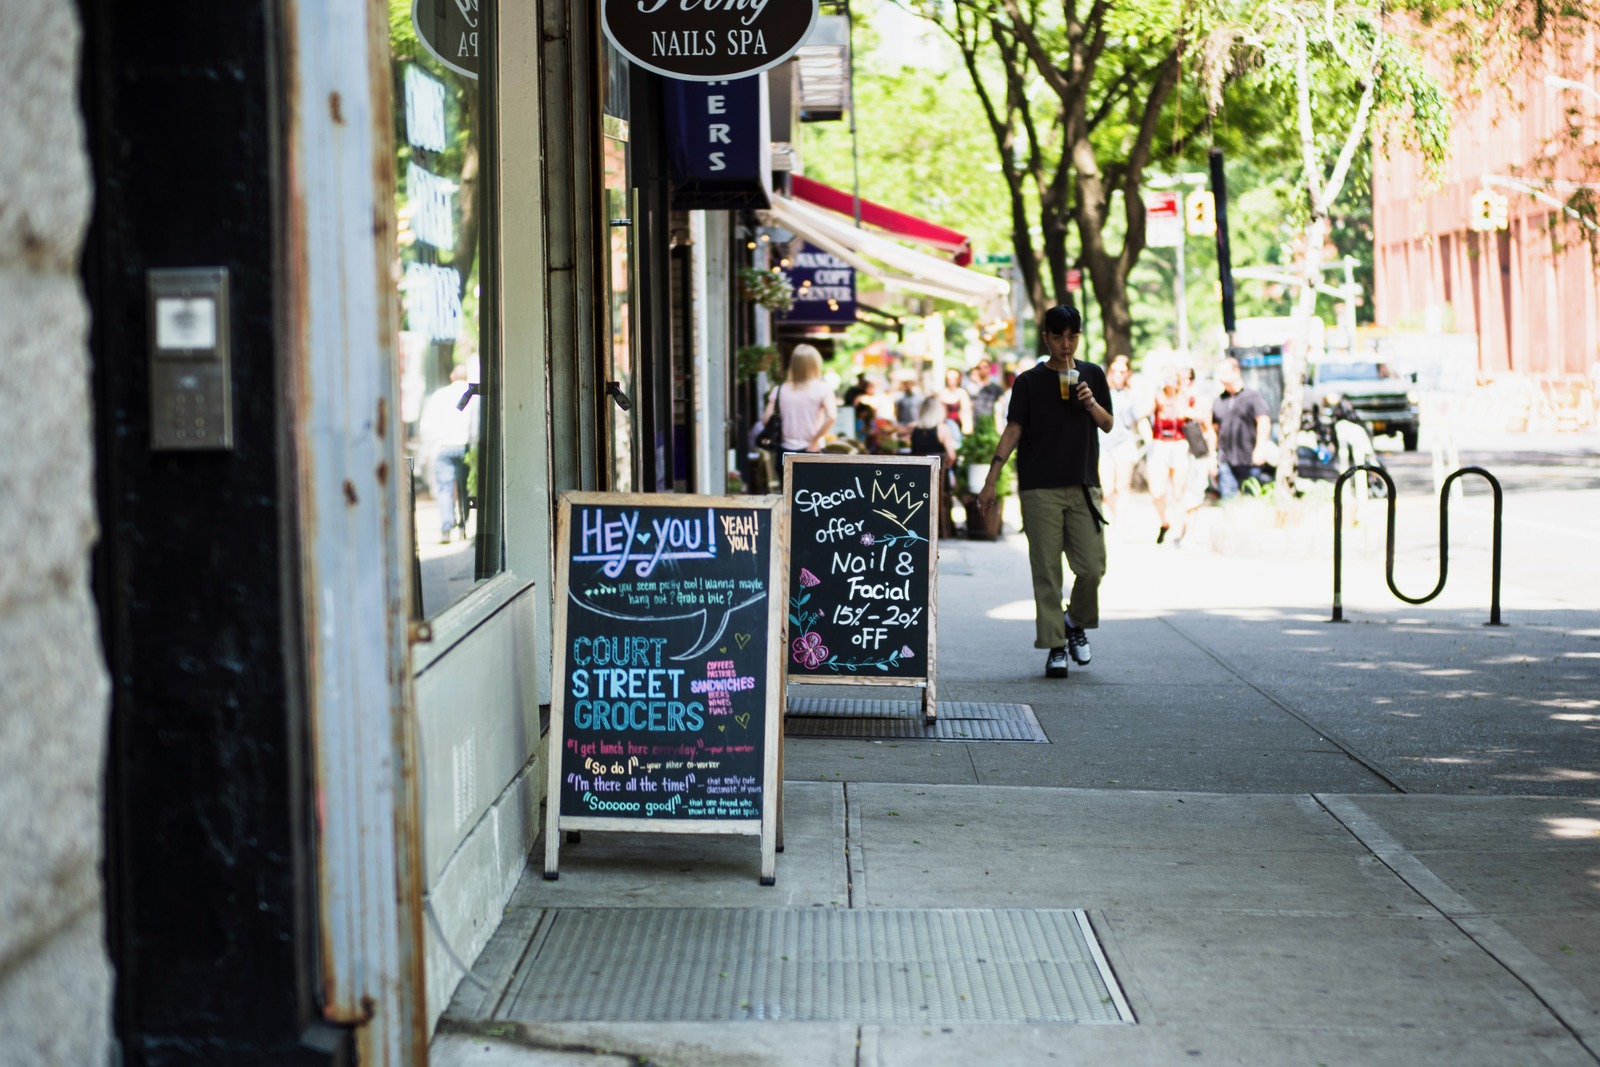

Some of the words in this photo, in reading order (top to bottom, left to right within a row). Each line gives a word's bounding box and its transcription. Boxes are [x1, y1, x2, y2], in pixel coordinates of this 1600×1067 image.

[651, 30, 717, 56] NAILS
[727, 29, 768, 56] SPA
[707, 81, 732, 171] ERS
[814, 269, 852, 285] COPY
[795, 477, 865, 517] Special
[720, 510, 759, 535] YEAH!
[815, 518, 865, 543] offer
[831, 544, 888, 575] Nail
[895, 551, 914, 576] &
[636, 581, 657, 591] seem
[739, 578, 764, 593] maybe
[847, 576, 910, 601] Facial
[628, 593, 650, 609] hang
[699, 594, 705, 604] a
[574, 636, 667, 667] COURT
[572, 669, 685, 698] STREET
[690, 676, 756, 694] SANDWICHES
[708, 699, 732, 707] WINES
[574, 701, 705, 731] GROCERS
[580, 741, 597, 758] get
[600, 739, 624, 755] lunch
[627, 740, 649, 755] here
[610, 760, 625, 775] do
[665, 760, 684, 769] other
[593, 775, 622, 792] there
[625, 777, 637, 792] all
[639, 775, 658, 792] the
[705, 799, 717, 807] one
[719, 797, 739, 807] friend
[739, 798, 753, 807] who
[707, 806, 715, 815] all
[717, 807, 727, 815] the
[729, 807, 741, 816] best
